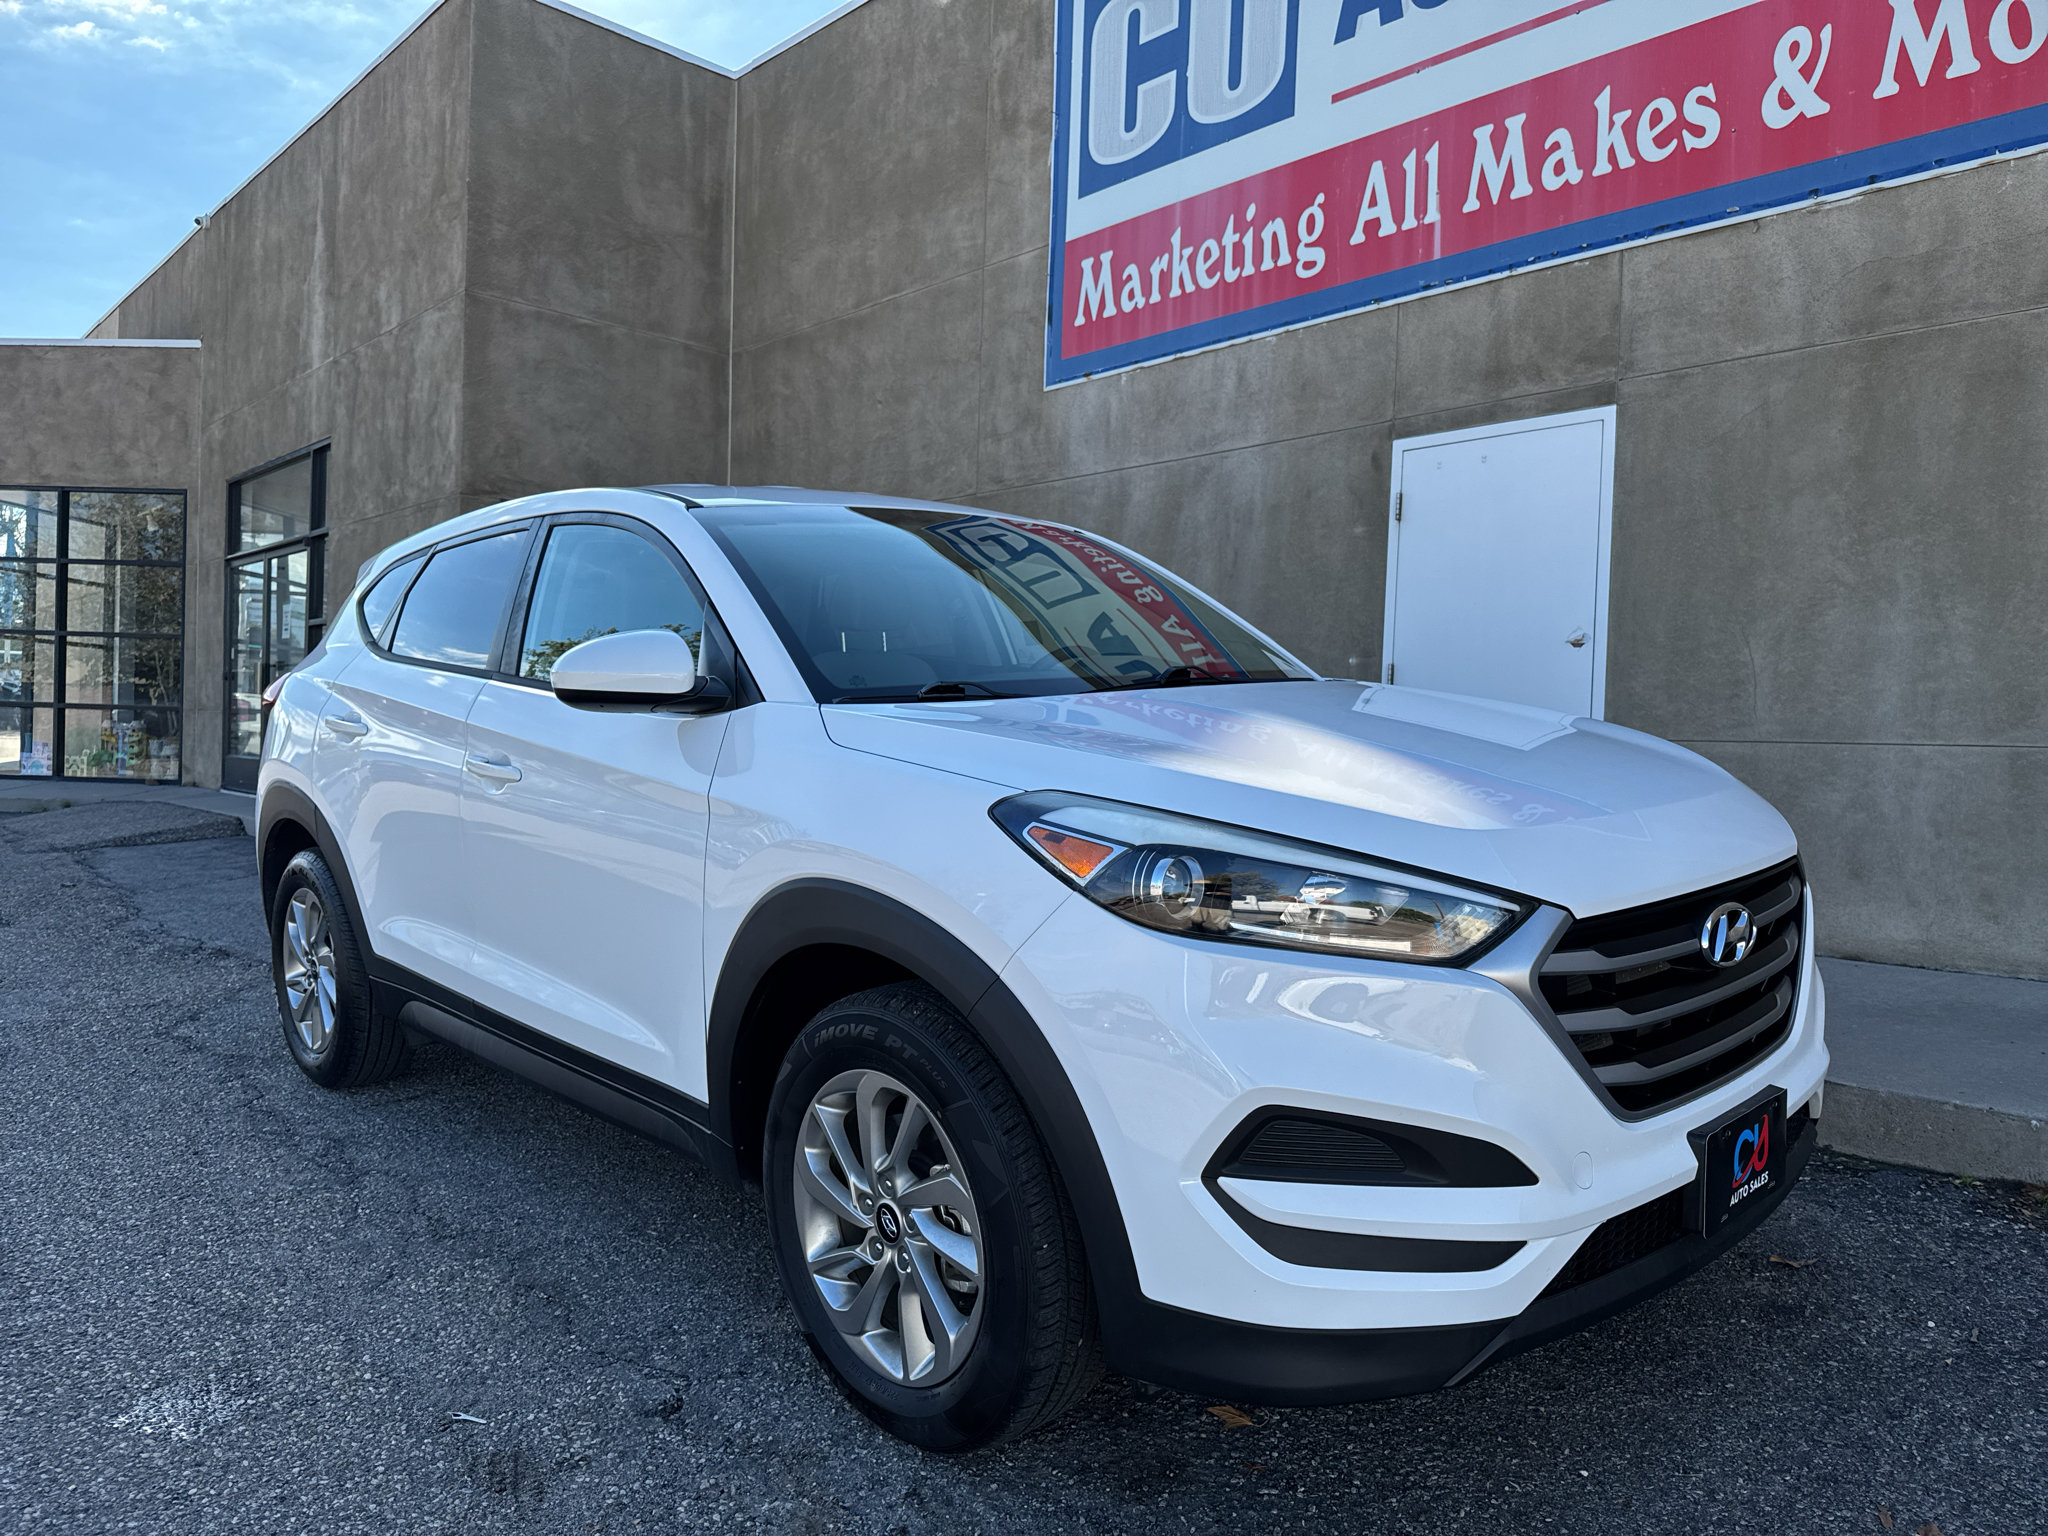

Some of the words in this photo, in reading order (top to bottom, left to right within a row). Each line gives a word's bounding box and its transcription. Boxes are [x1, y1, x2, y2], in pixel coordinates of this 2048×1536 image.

[1073, 192, 1326, 328] Marketing
[1349, 139, 1441, 246] All
[1462, 82, 1721, 214] Makes
[1761, 23, 1832, 129] &
[814, 1023, 879, 1048] iMOVE
[884, 1034, 919, 1060] PT
[919, 1058, 949, 1089] PLUS
[1730, 1185, 1748, 1206] AUTO
[1749, 1171, 1769, 1193] SALES
